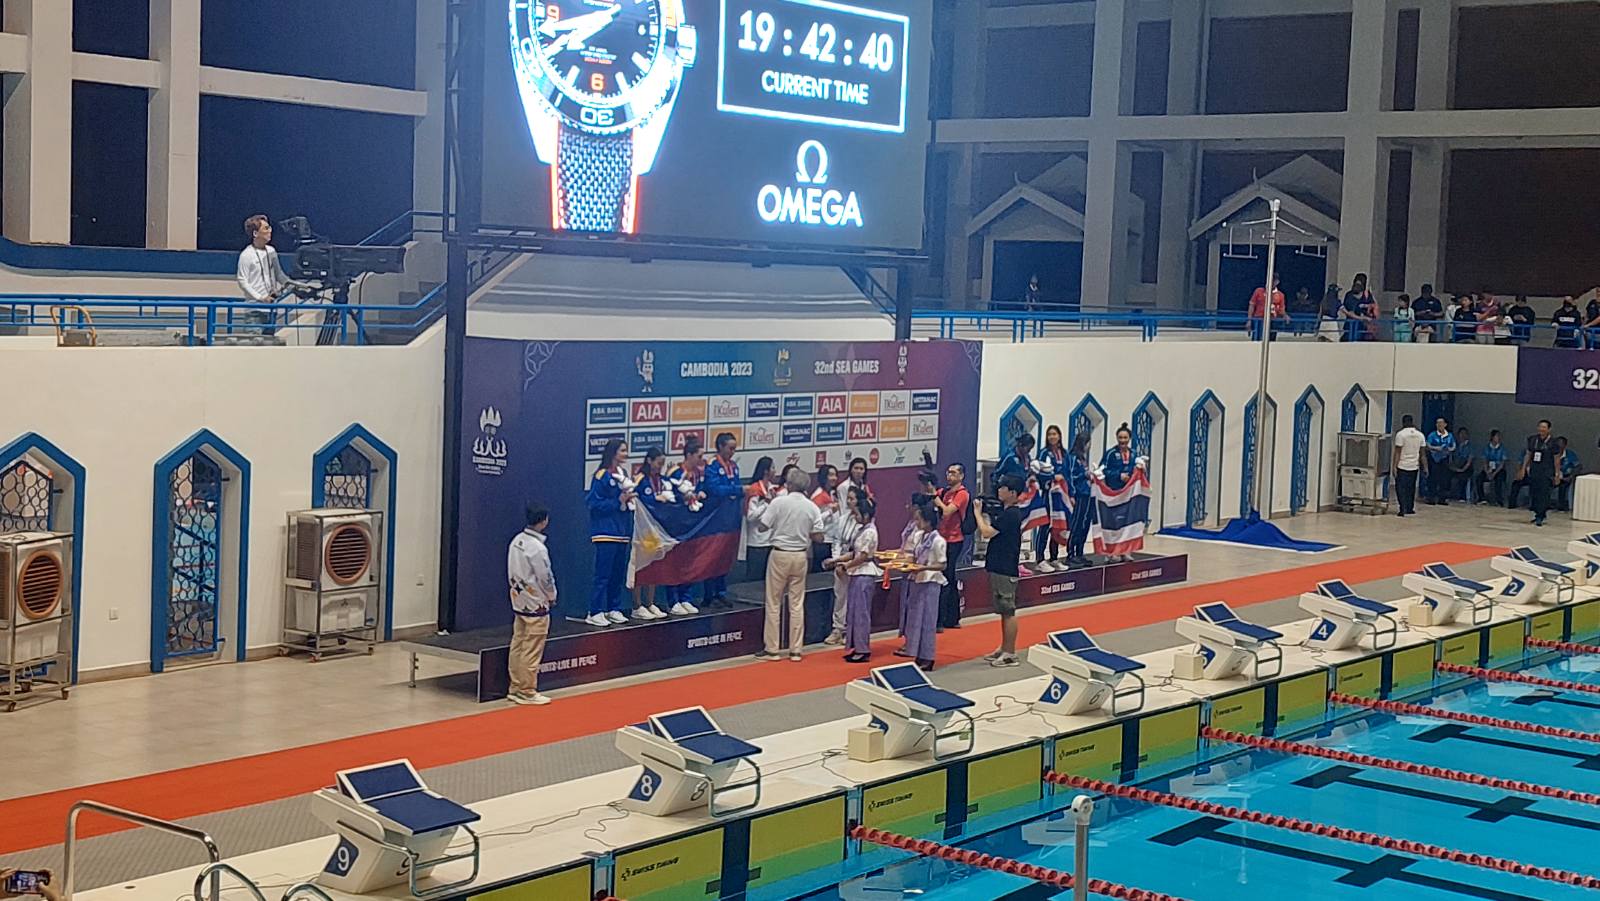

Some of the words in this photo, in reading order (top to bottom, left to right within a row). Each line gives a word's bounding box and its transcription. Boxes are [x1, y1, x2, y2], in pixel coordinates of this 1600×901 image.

[591, 73, 605, 91] 6
[761, 70, 832, 100] CURRENT
[835, 79, 870, 104] TIME
[757, 185, 864, 227] OMEGA
[681, 362, 729, 377] CAMBODIA
[731, 361, 753, 376] 2023
[814, 361, 835, 375] 32nd
[835, 361, 850, 375] SEA
[852, 360, 880, 374] GAMES
[636, 404, 662, 420] AIA
[821, 397, 843, 413] AIA
[852, 423, 874, 438] AIA
[1509, 581, 1519, 596] 2
[1318, 624, 1329, 639] 4
[1050, 683, 1061, 699] 6
[640, 775, 653, 797] 8
[337, 846, 350, 870] 9
